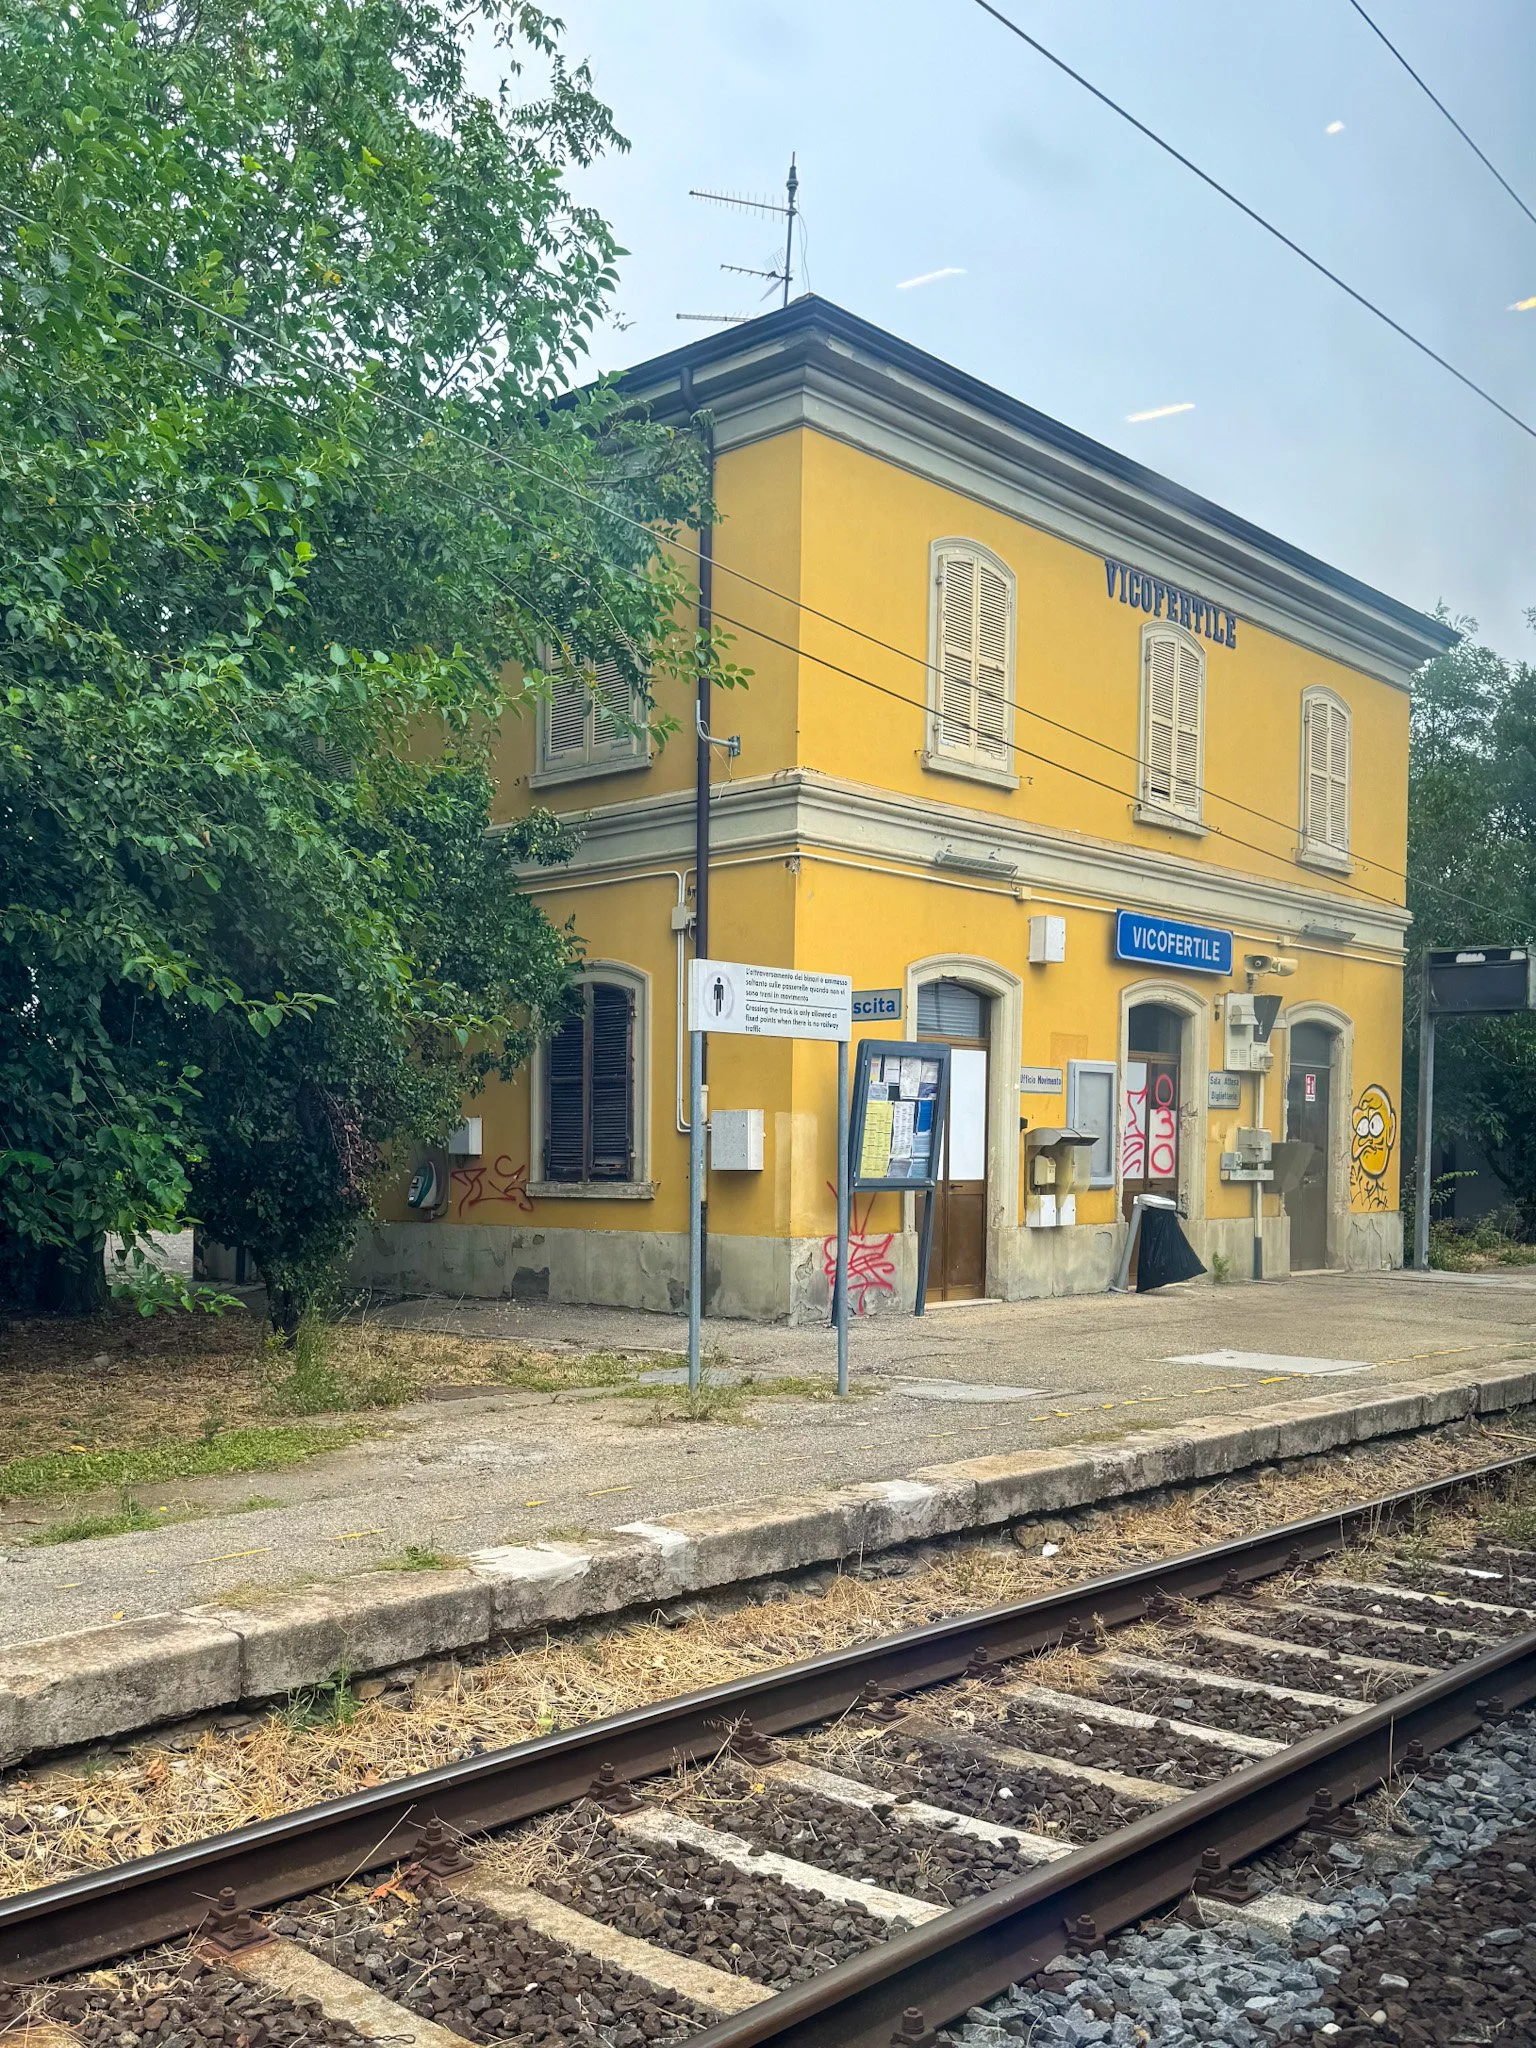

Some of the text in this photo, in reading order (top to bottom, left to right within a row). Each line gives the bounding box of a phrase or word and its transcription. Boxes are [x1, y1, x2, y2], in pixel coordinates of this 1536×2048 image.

[1104, 558, 1238, 649] VICOFERTILE
[1133, 926, 1220, 962] VICOFERTILE
[780, 992, 809, 1002] movimento
[745, 1004, 768, 1014] Crossing
[769, 1006, 778, 1014] the
[779, 1007, 792, 1015] track
[793, 1008, 798, 1016] is
[799, 1009, 811, 1018] only
[811, 1010, 831, 1018] allowed
[853, 997, 896, 1014] scita
[745, 1014, 759, 1022] fixed
[759, 1016, 776, 1024] points
[792, 1018, 806, 1026] there
[807, 1019, 812, 1027] is
[820, 1020, 839, 1030] railway
[745, 1024, 761, 1033] traffic
